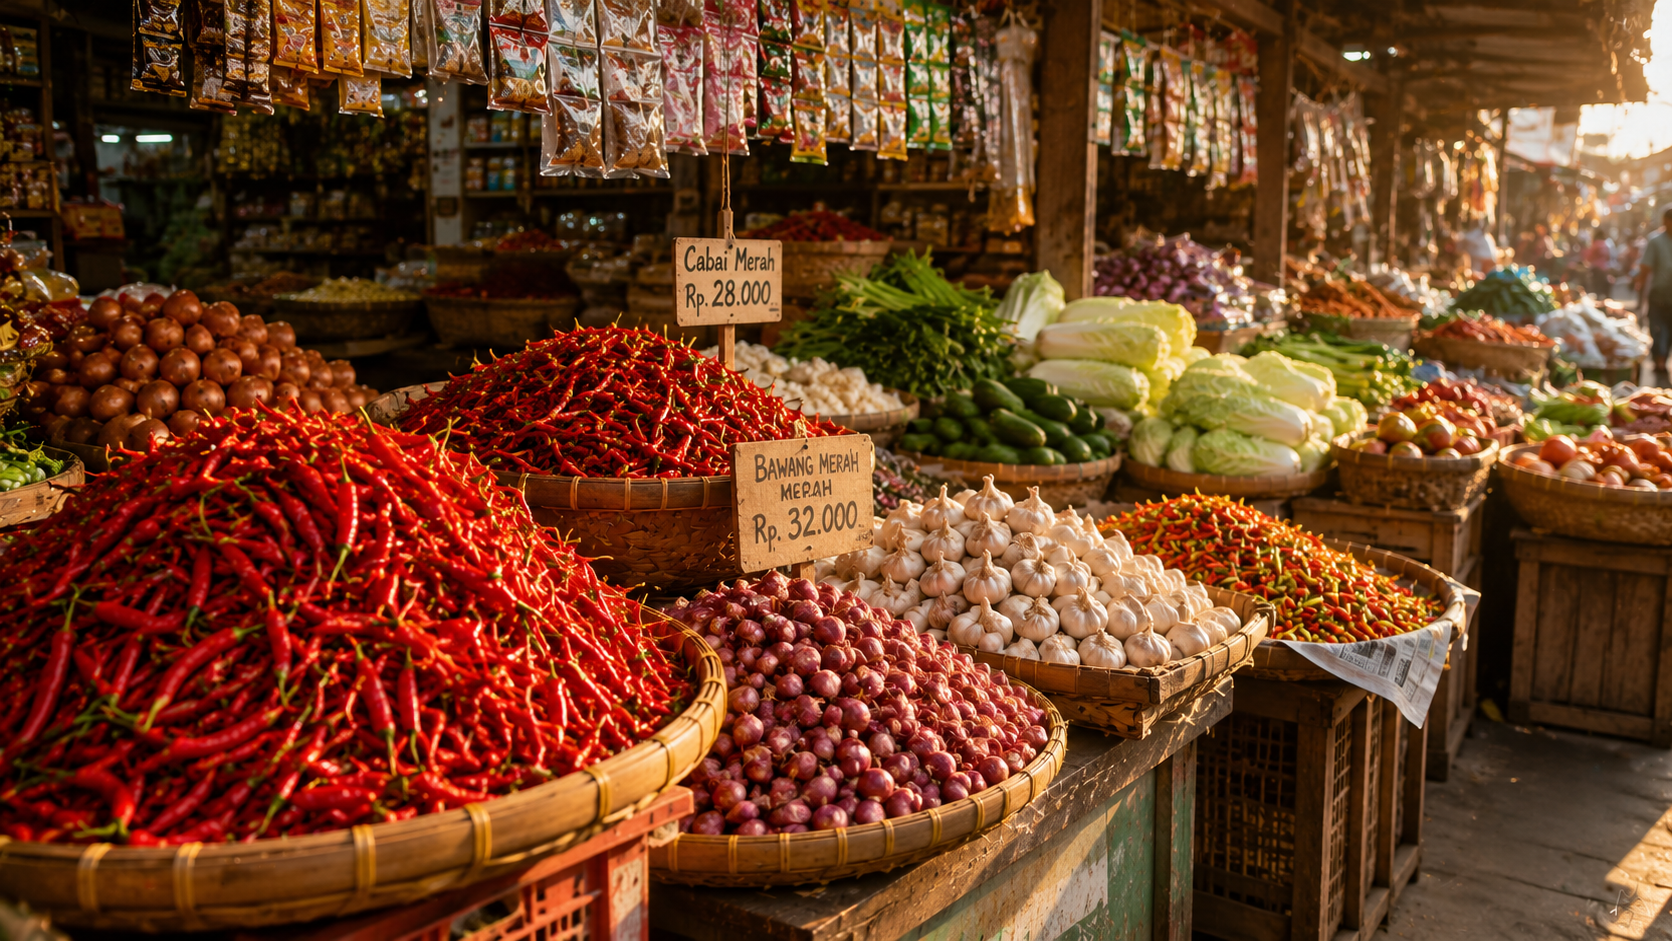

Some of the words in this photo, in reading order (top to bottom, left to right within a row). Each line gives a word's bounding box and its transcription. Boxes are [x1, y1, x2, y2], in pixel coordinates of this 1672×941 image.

[684, 245, 727, 272] Cabai
[734, 247, 775, 272] Merah
[685, 283, 708, 317] Rp.
[711, 279, 771, 307] 28.000
[754, 453, 814, 483] BAWANG
[819, 449, 859, 474] MERAH
[752, 513, 781, 553] Rp.
[788, 500, 858, 540] 32.000
